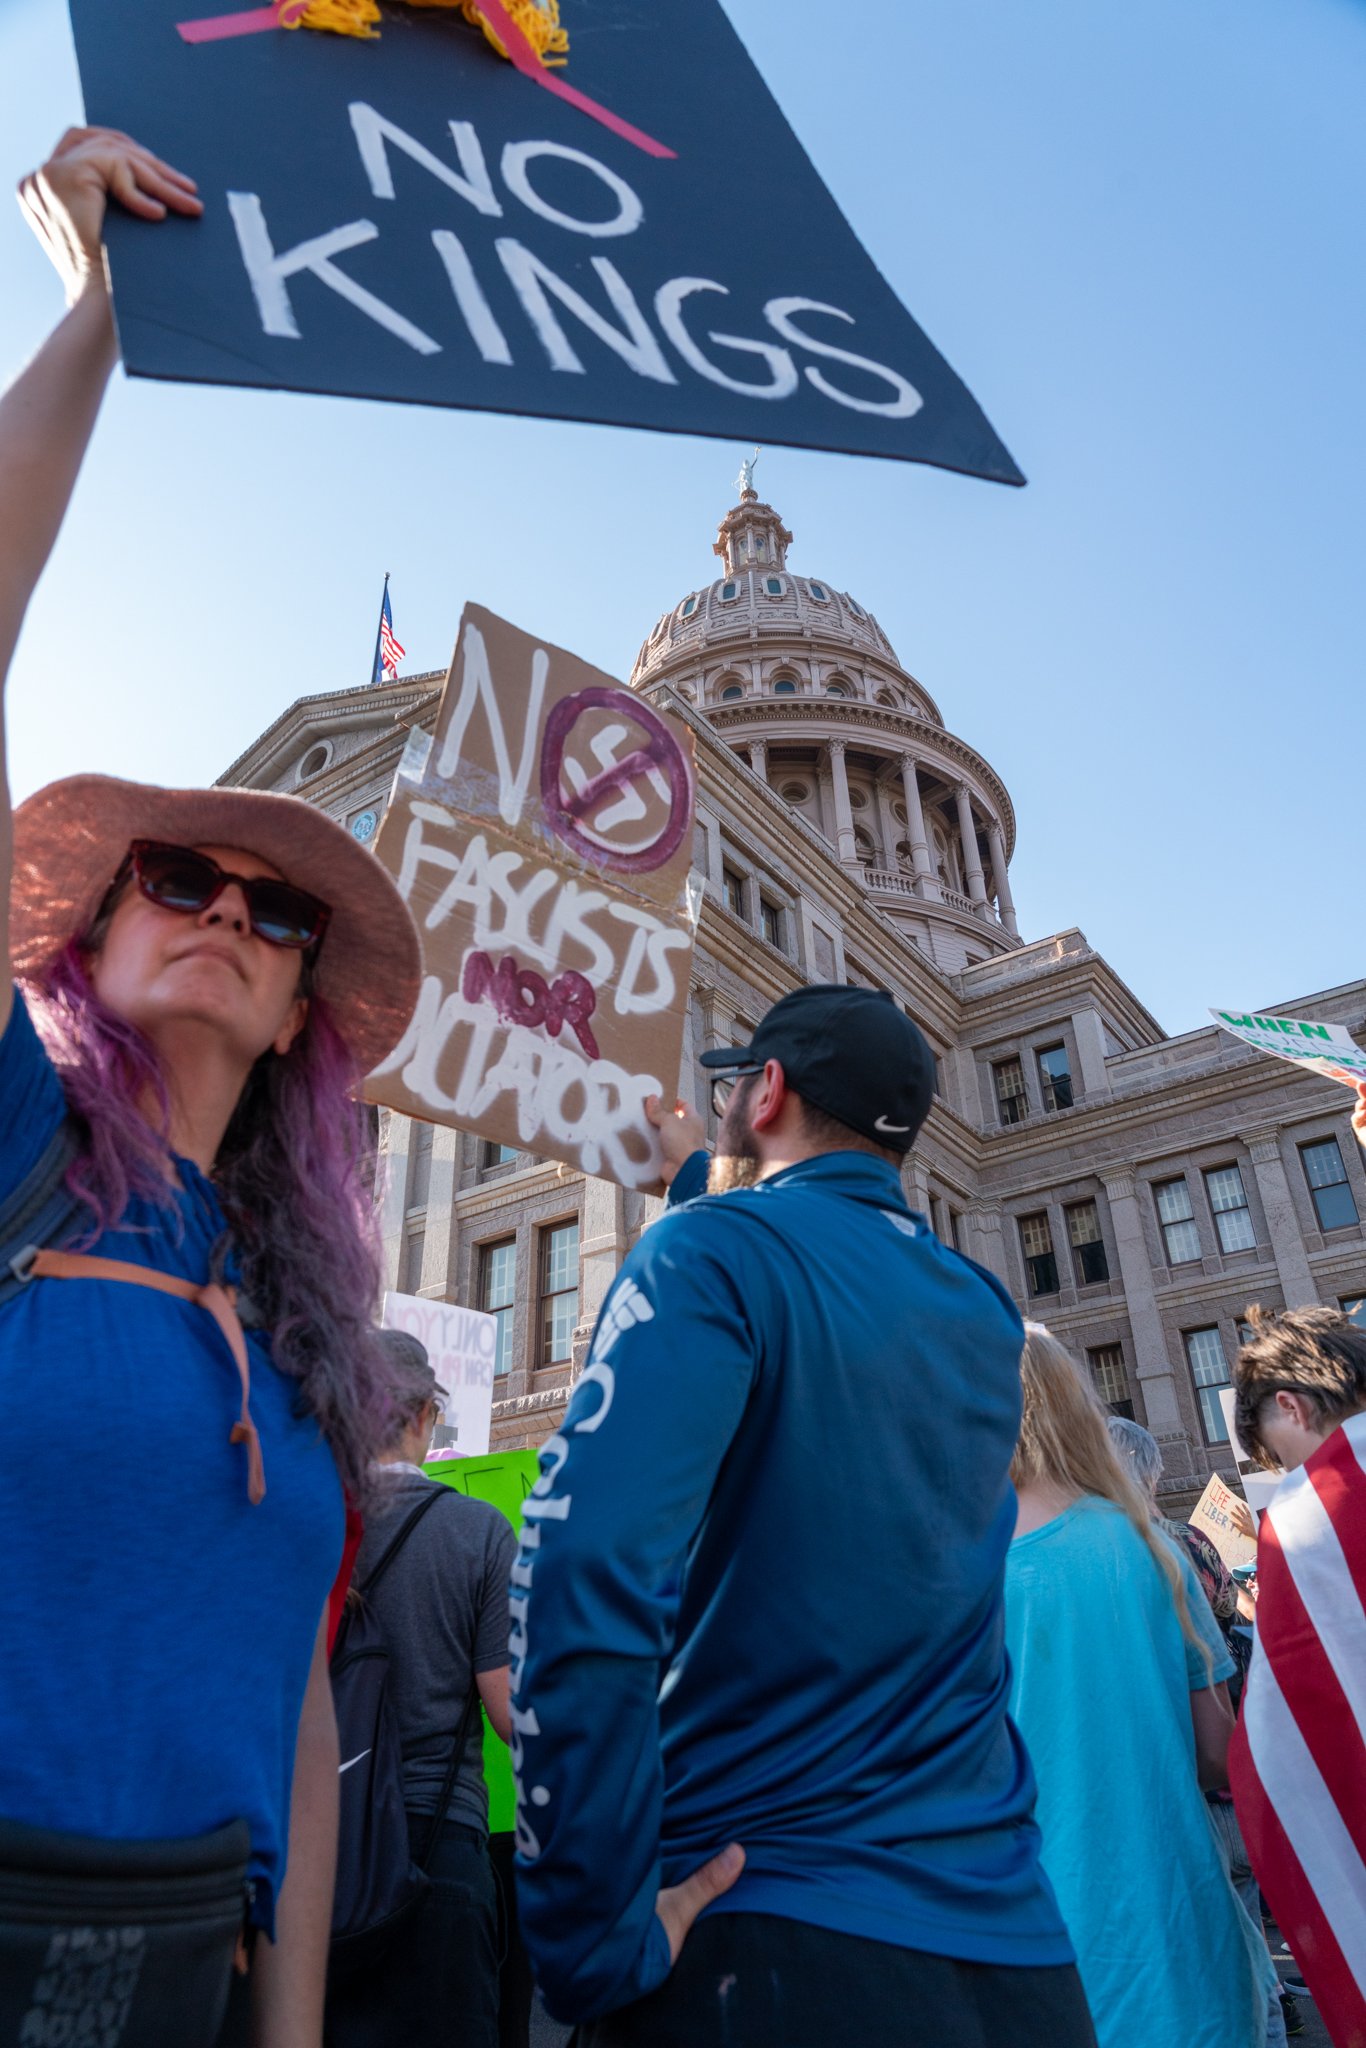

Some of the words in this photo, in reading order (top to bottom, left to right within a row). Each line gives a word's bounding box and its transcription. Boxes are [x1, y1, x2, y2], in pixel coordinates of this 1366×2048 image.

[347, 100, 643, 237] NO
[226, 191, 923, 419] KINGS
[462, 951, 600, 1061] NOR
[1218, 1012, 1333, 1042] WHEN
[1209, 1482, 1231, 1510] LIFE
